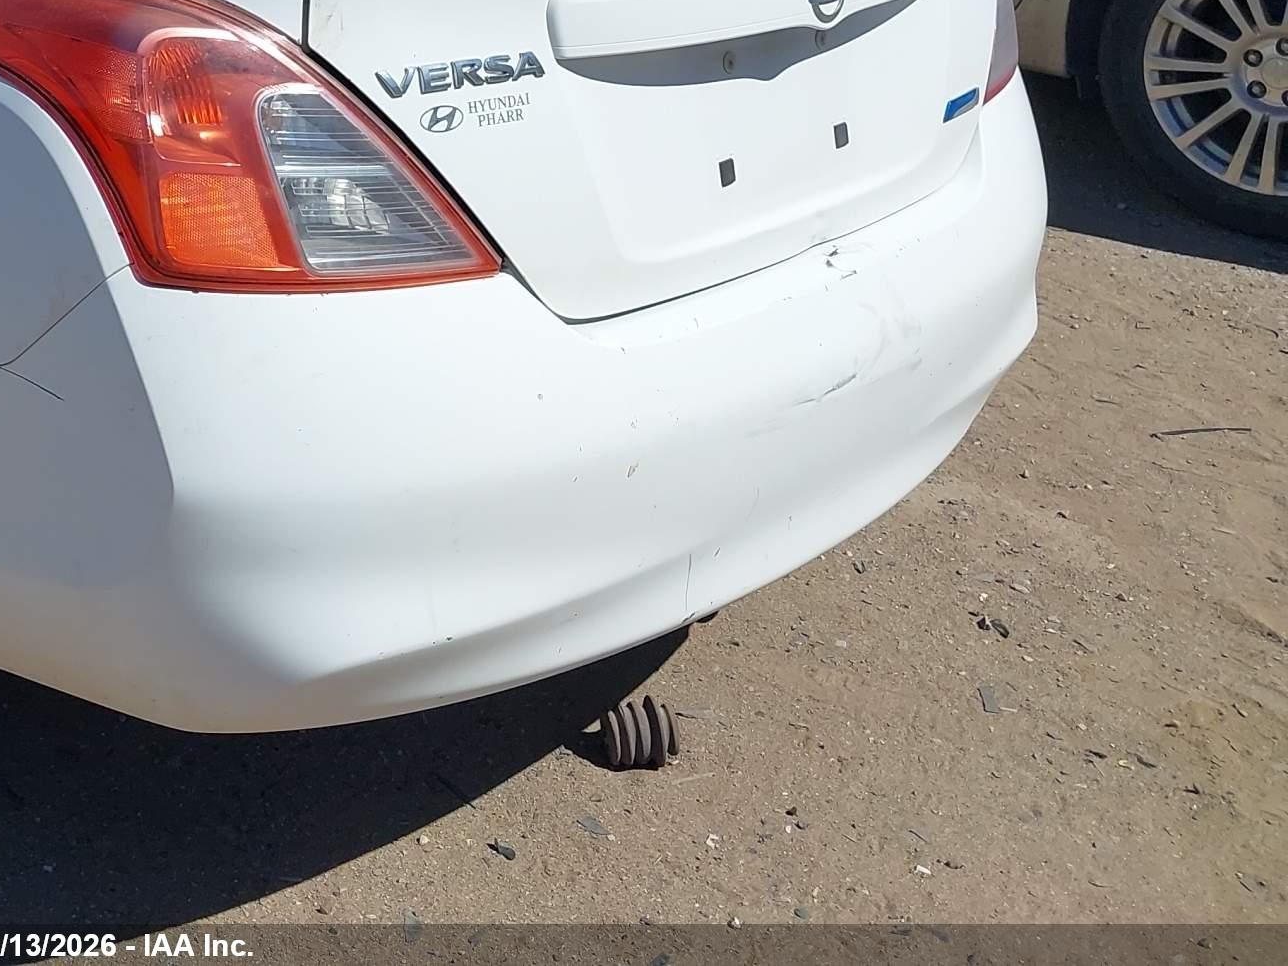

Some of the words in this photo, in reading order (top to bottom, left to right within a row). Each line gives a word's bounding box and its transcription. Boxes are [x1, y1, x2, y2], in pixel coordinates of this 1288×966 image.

[374, 50, 546, 99] VERSA
[468, 92, 531, 114] HYUNDAI
[477, 108, 525, 127] PHARR
